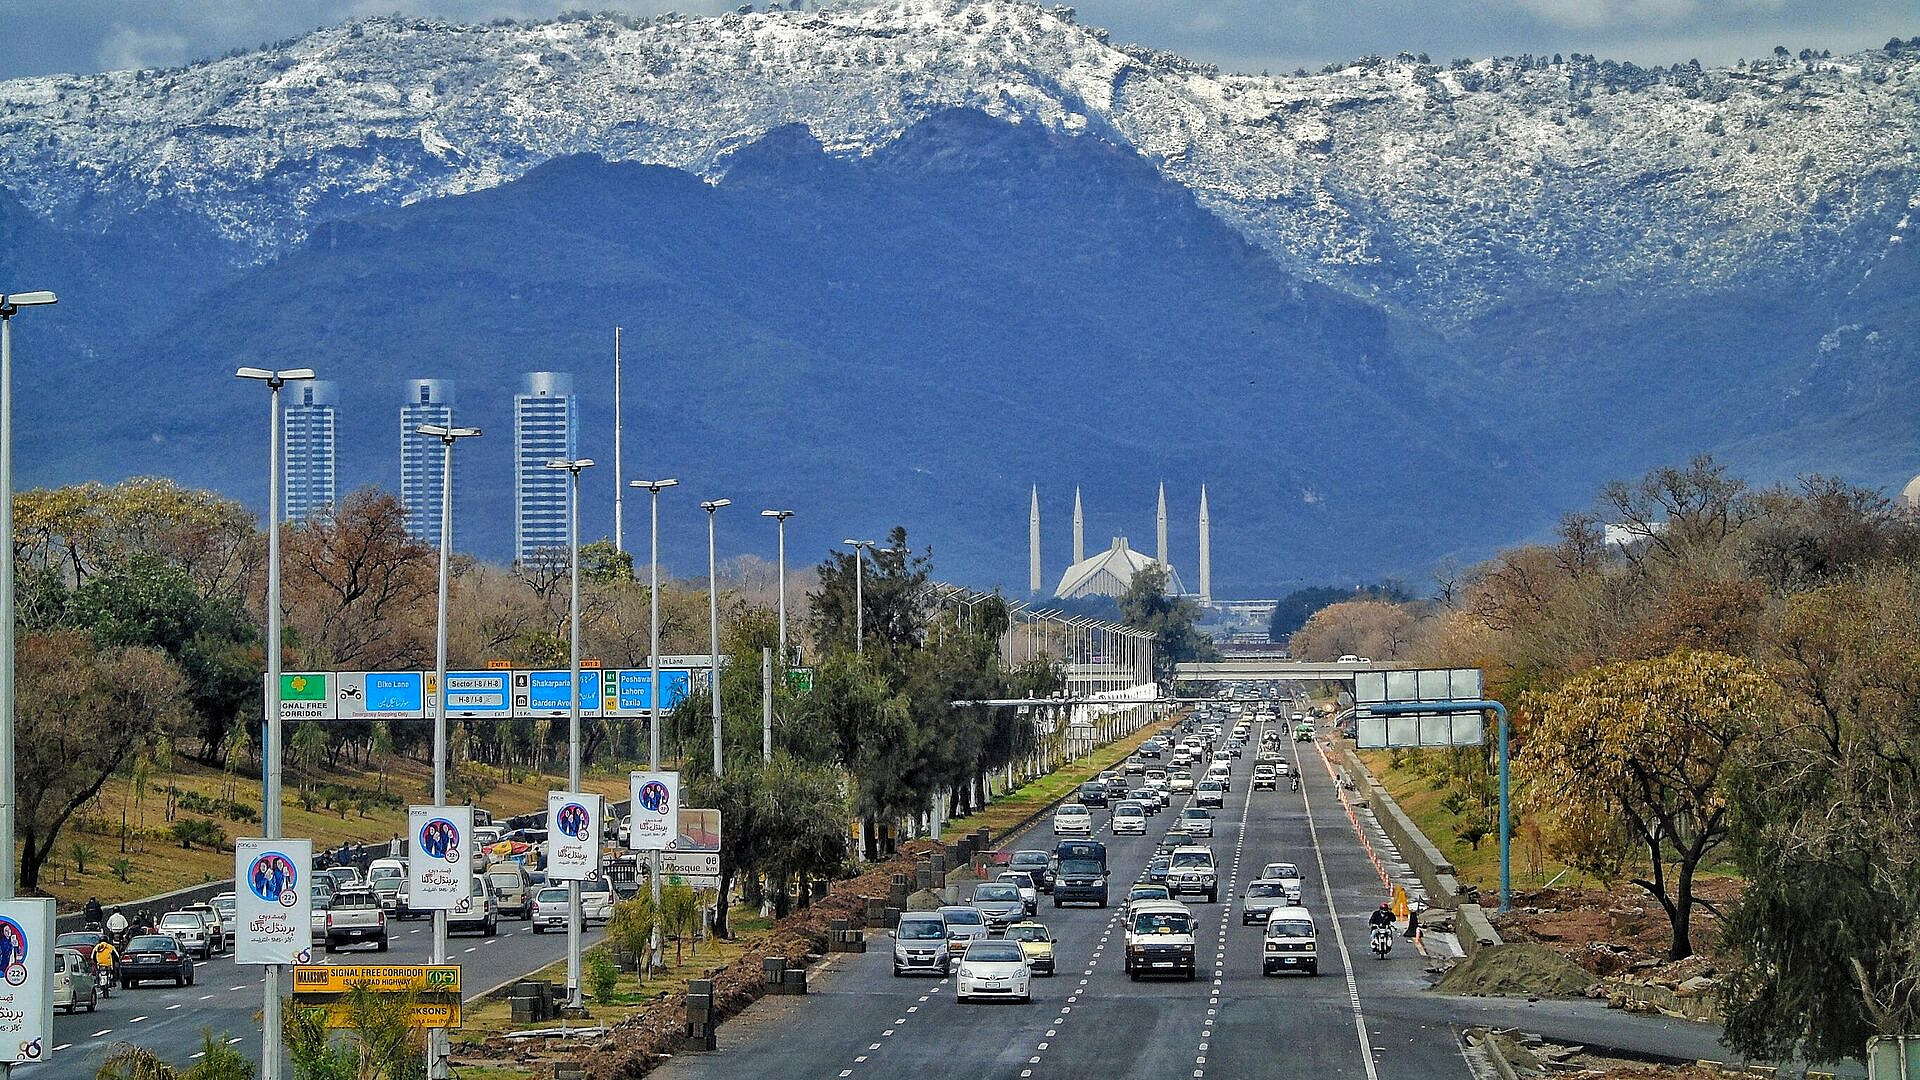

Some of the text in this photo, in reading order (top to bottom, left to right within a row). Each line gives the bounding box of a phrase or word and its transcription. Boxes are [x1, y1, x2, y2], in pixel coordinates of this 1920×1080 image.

[452, 680, 473, 688] Sector
[621, 687, 645, 695] Lahore
[532, 699, 555, 707] Garden
[621, 698, 641, 706] Taxila
[705, 857, 717, 865] 08
[665, 863, 700, 872] Mosque
[330, 968, 424, 977] SIGNAL FREE CORRIDOR
[381, 978, 411, 986] HIGHWAY
